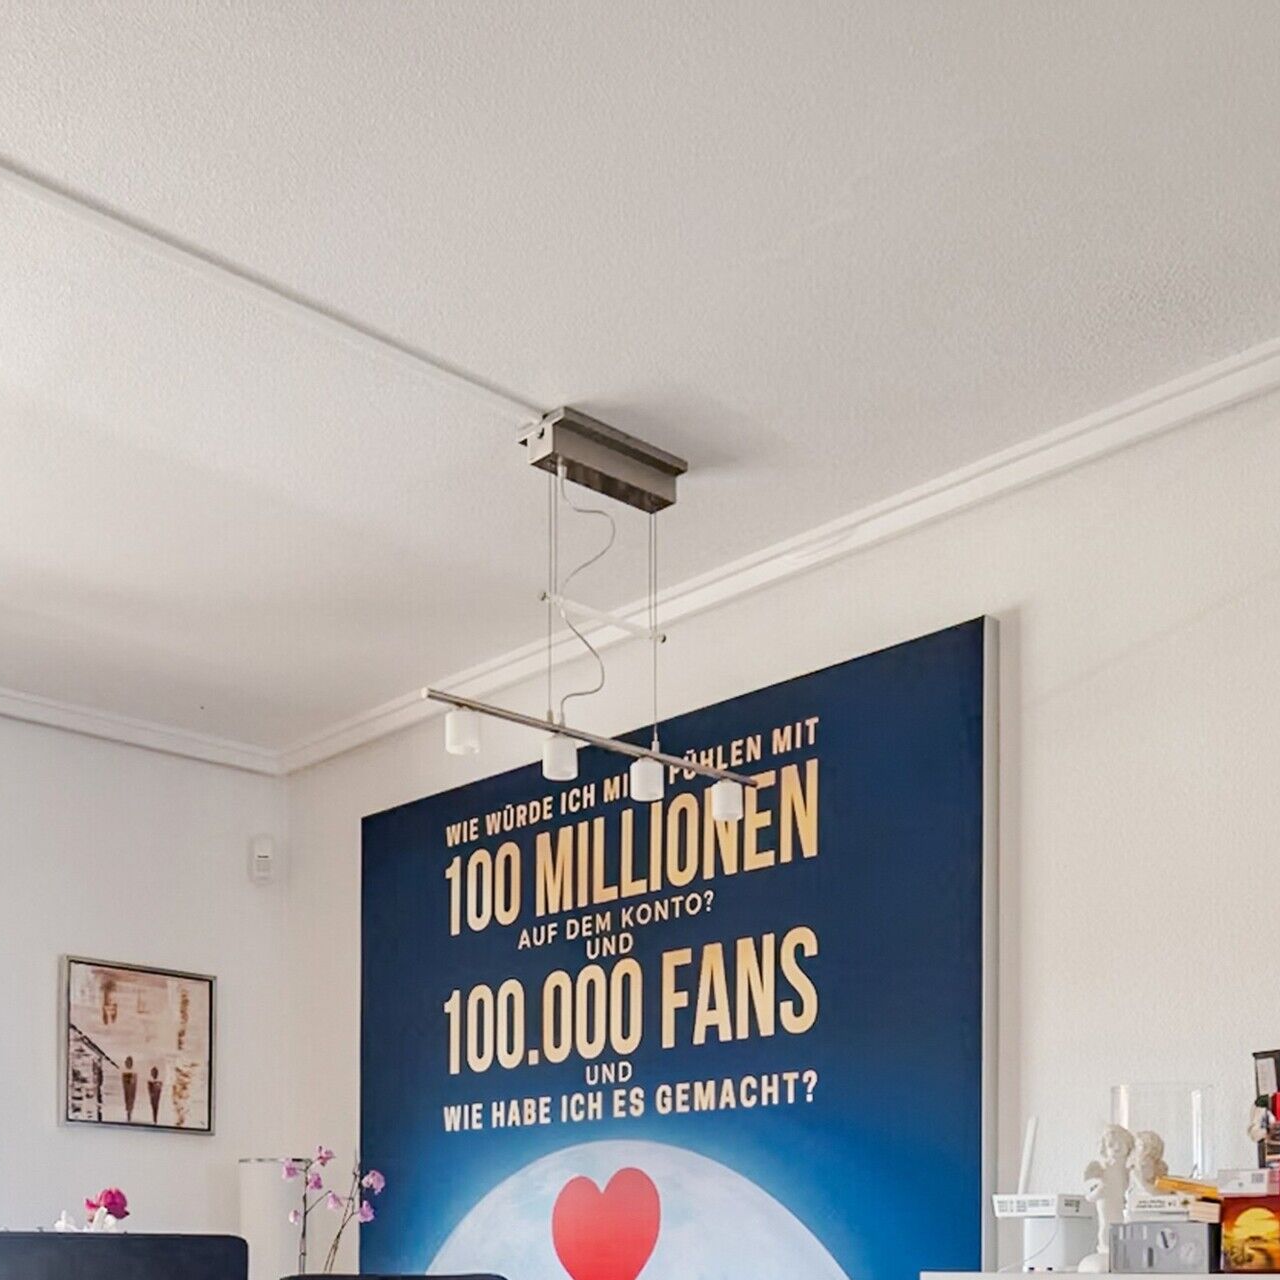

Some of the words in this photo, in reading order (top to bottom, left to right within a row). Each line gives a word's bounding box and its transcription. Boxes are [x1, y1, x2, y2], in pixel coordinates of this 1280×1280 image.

[446, 820, 479, 847] WIE
[485, 795, 554, 835] WÜRDE
[560, 783, 596, 816] ICH
[772, 716, 819, 755] MIT
[445, 841, 522, 937] 100
[535, 758, 819, 917] MILLIONEN
[518, 922, 558, 950] AUF
[566, 911, 612, 942] DEM
[621, 889, 715, 928] KONTO?
[586, 932, 634, 961] UND
[444, 957, 643, 1075] 100.000
[661, 925, 818, 1050] FANS
[443, 1103, 483, 1132] WIE
[491, 1096, 551, 1128] HABE
[561, 1091, 602, 1122] ICH
[613, 1087, 645, 1119] ES
[655, 1070, 818, 1116] GEMACHT?
[585, 1060, 633, 1086] UND
